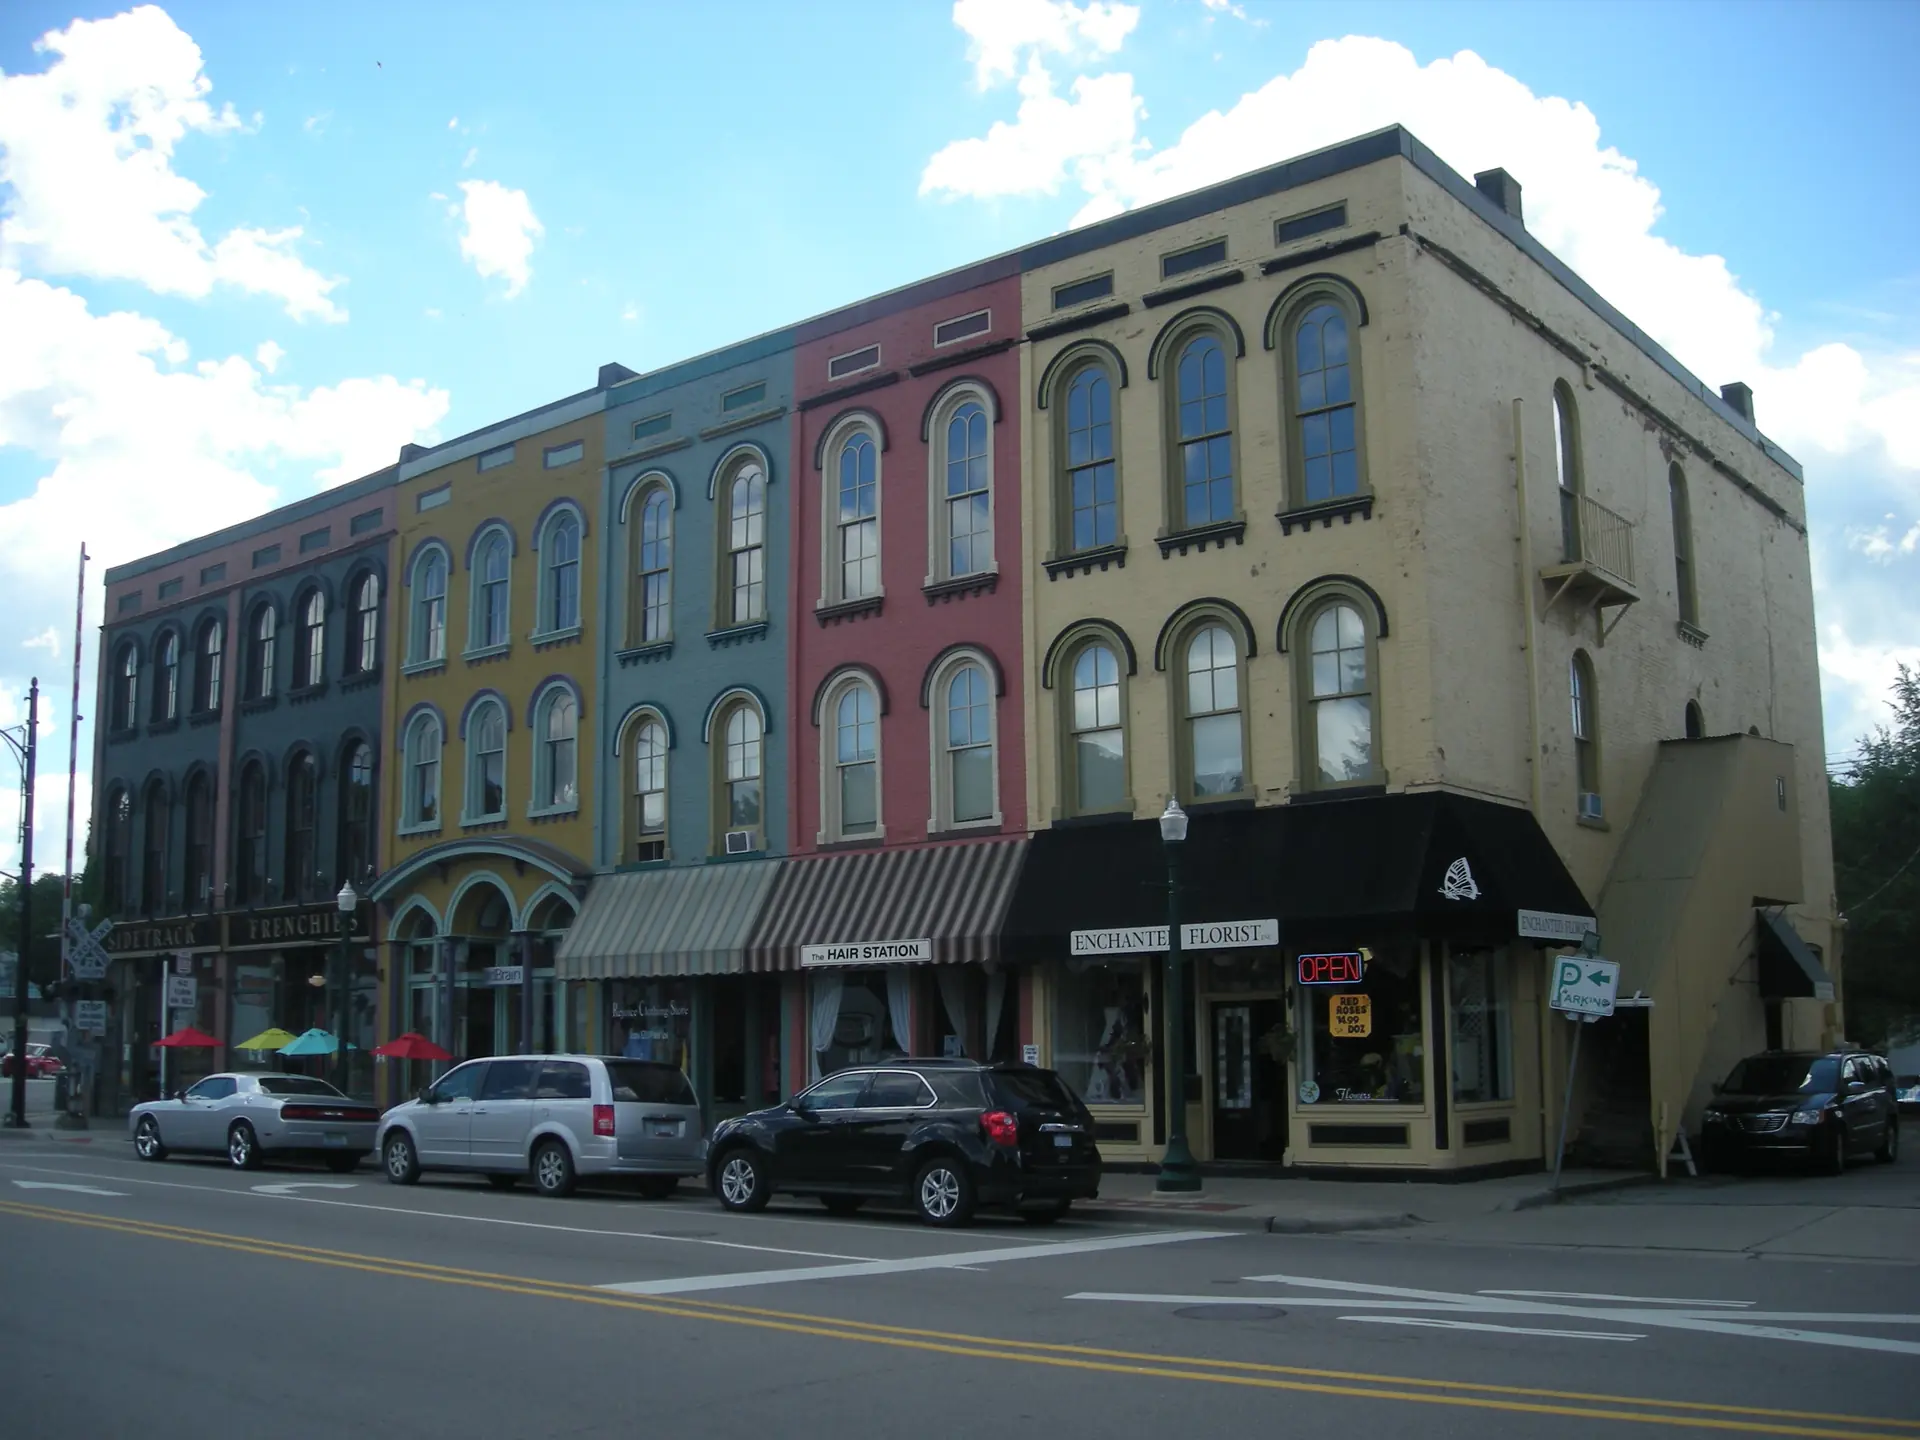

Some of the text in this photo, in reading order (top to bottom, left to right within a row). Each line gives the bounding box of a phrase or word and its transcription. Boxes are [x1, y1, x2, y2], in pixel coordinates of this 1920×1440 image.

[108, 922, 196, 950] SIDETRACK
[1076, 929, 1171, 950] ENCHANTE
[1189, 925, 1262, 944] FLORIST
[827, 948, 859, 960] HAIR
[863, 945, 919, 958] STATION
[1301, 956, 1360, 981] OPEN
[1336, 1006, 1367, 1014] ROSES
[1340, 997, 1359, 1005] RED
